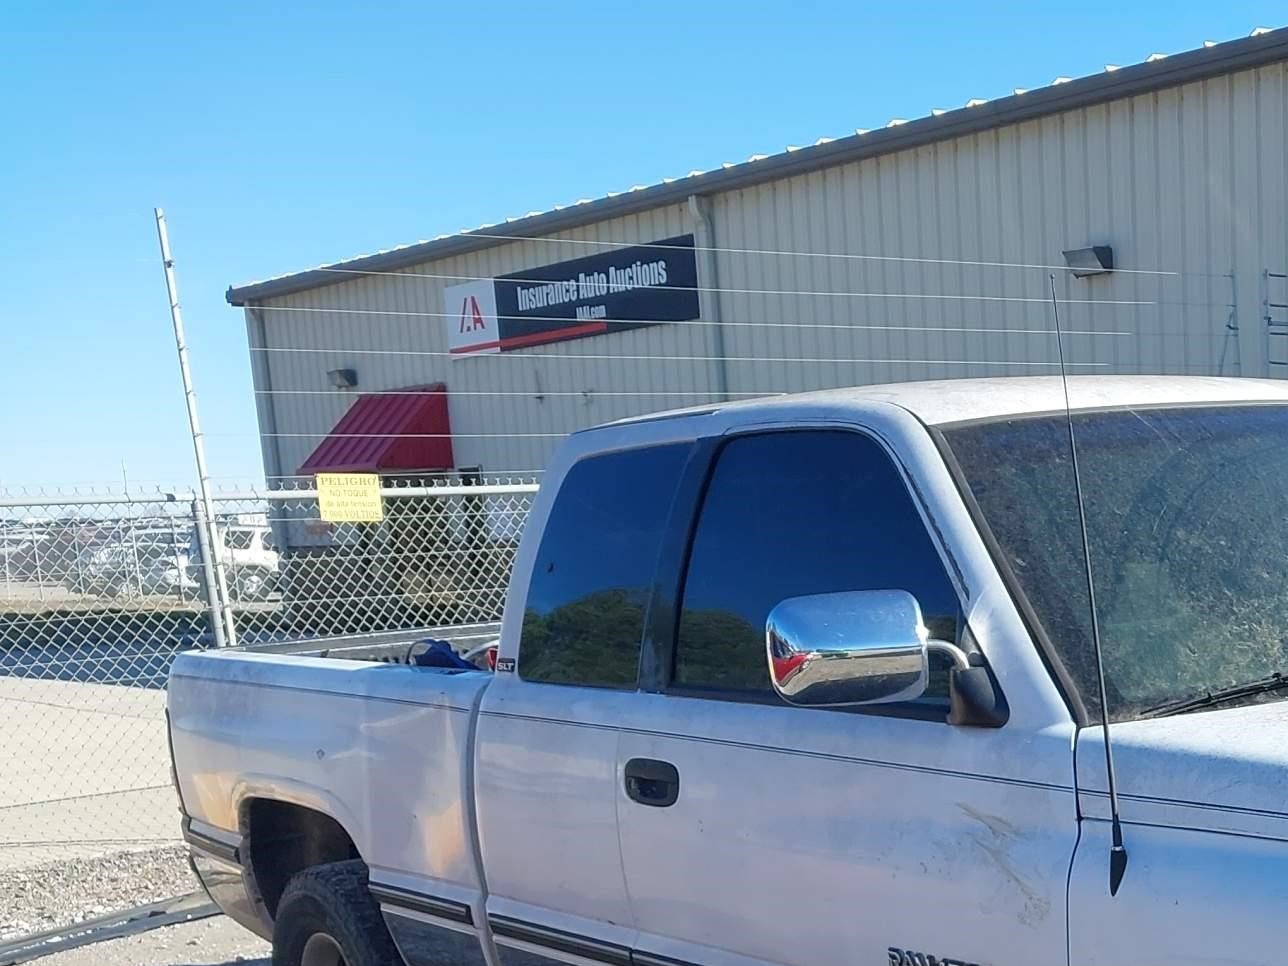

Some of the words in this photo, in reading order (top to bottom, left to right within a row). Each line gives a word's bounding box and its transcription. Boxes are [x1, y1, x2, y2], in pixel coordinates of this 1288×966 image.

[516, 278, 578, 312] Insurance
[578, 271, 607, 300] Auto
[608, 260, 668, 294] Auctions
[320, 476, 377, 486] PELIGRO
[498, 662, 515, 671] SLT
